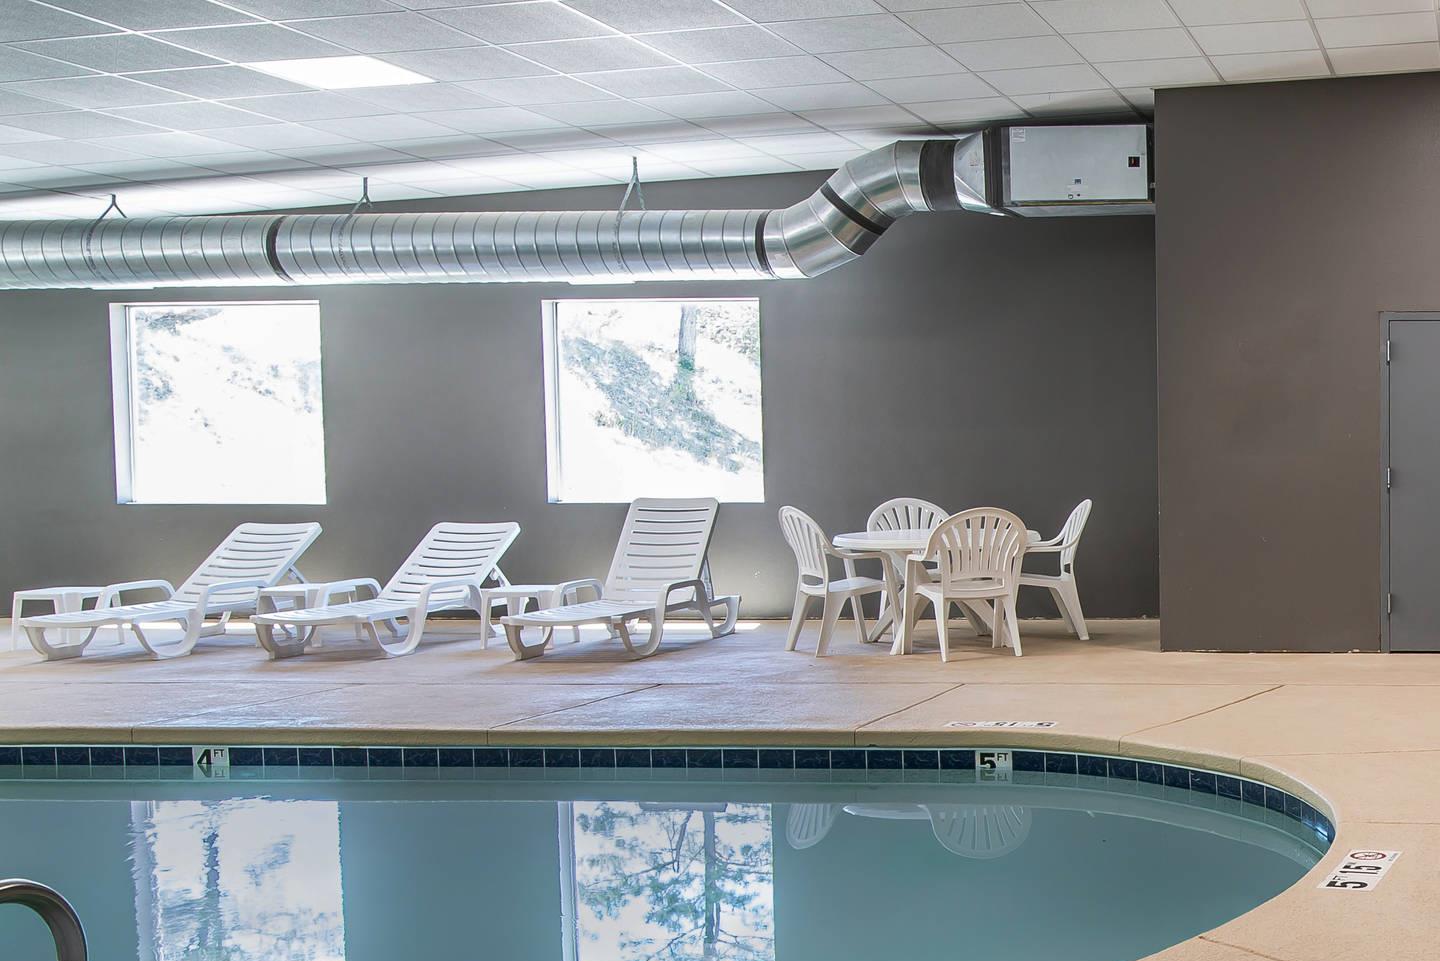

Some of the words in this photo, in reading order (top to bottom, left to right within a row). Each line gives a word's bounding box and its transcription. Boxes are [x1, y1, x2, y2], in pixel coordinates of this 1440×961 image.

[197, 748, 212, 765] 4
[213, 748, 225, 758] FT
[980, 752, 996, 769] 5
[997, 752, 1009, 761] FT
[1326, 881, 1368, 889] 5
